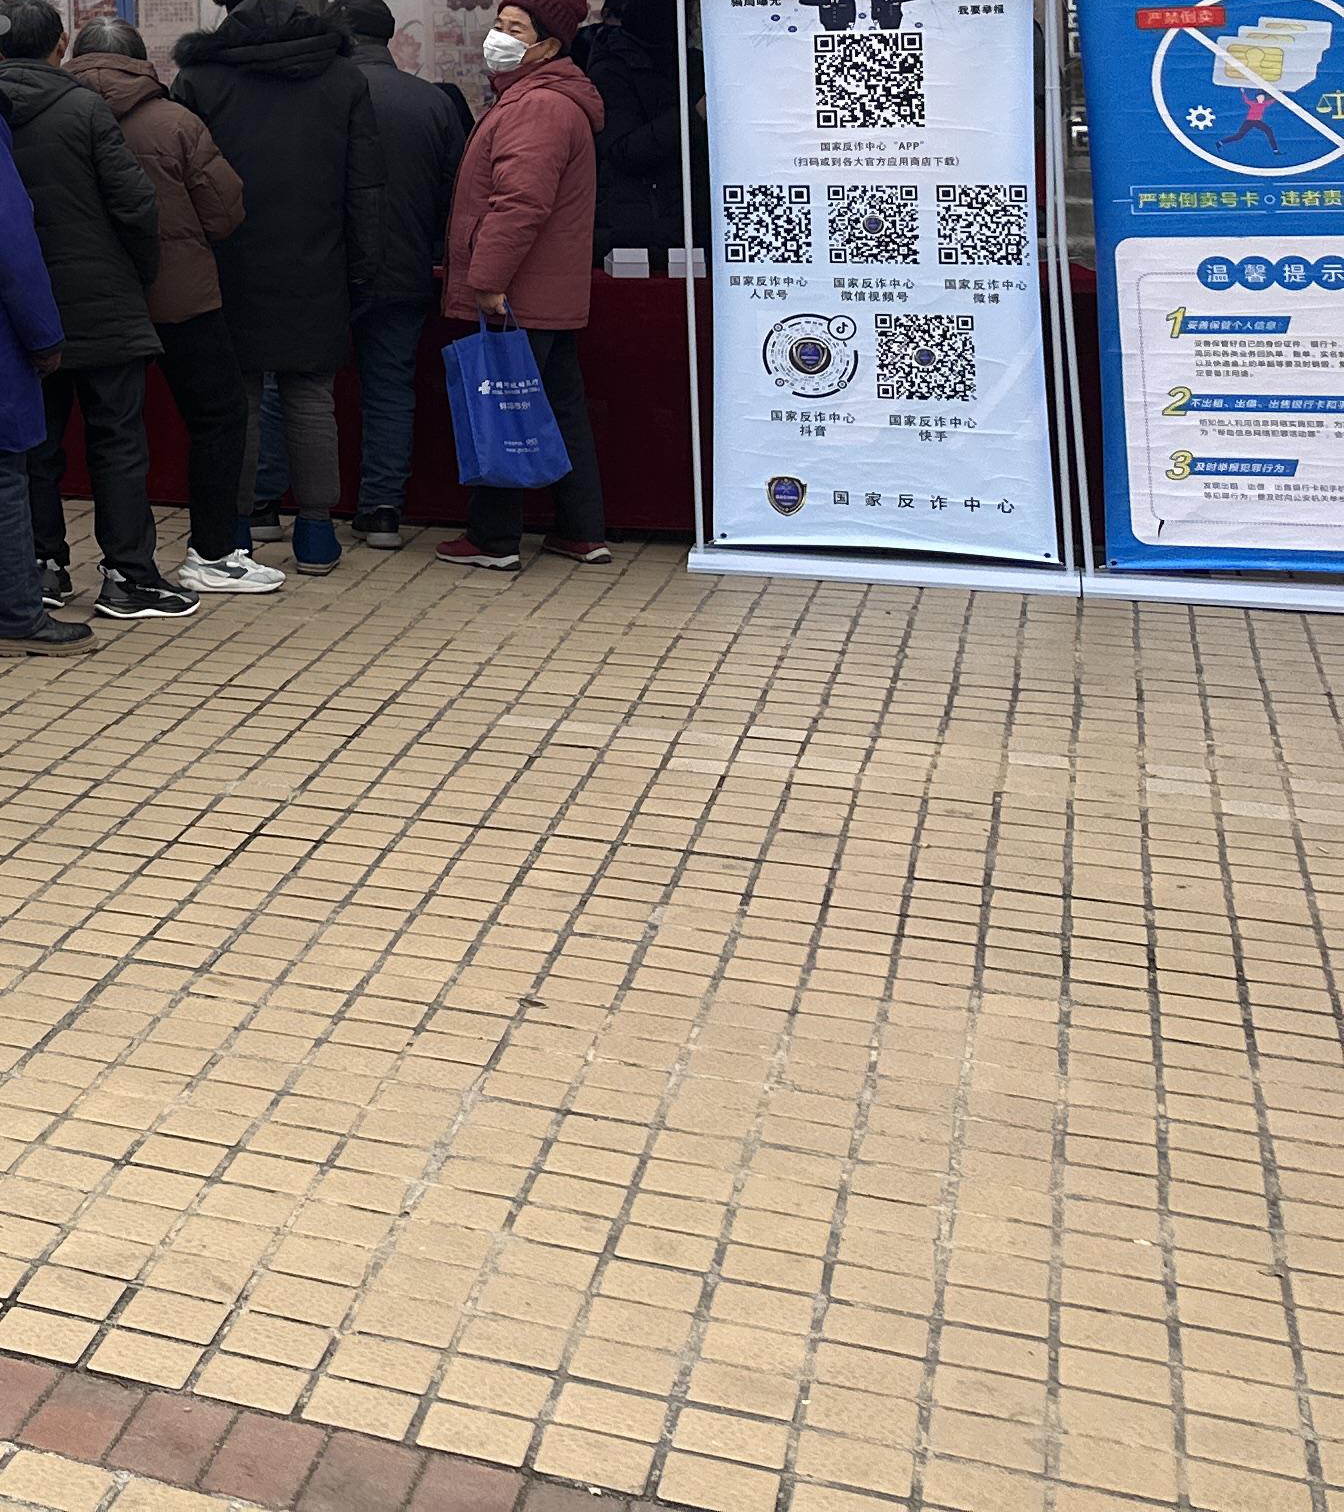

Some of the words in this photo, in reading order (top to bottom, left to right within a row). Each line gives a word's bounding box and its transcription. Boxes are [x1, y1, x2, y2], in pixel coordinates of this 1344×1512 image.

[957, 3, 1005, 15] 我要举报
[820, 142, 887, 153] 国家反诈中心
[1138, 190, 1260, 209] 严禁倒卖号卡
[1206, 263, 1344, 284] 温馨提示
[729, 275, 808, 287] 国家反诈中心
[833, 278, 915, 289] 国家反诈中心
[944, 279, 1028, 292] 国家反诈中心
[749, 288, 789, 301] 人民号
[840, 290, 909, 303] 微信视频号
[972, 292, 1001, 305] 微博
[1166, 306, 1187, 339] 1
[1162, 387, 1193, 417] 2
[770, 409, 856, 425] 国家反诈中心
[888, 414, 978, 429] 国家反诈中心
[799, 424, 827, 438] 抖音
[918, 430, 949, 443] 快手
[1165, 449, 1194, 481] 3
[833, 490, 1015, 514] 国家反诈中心
